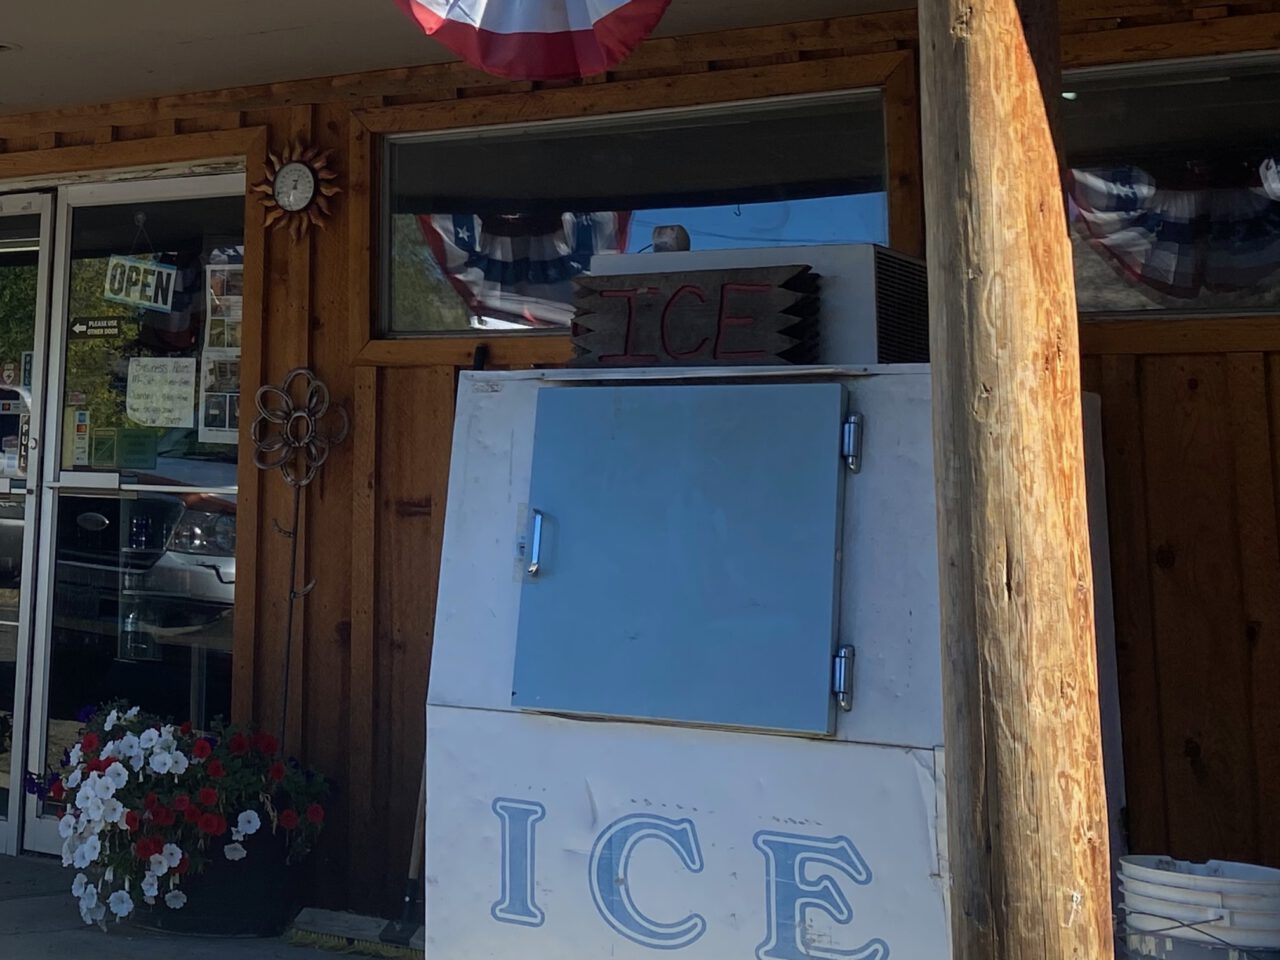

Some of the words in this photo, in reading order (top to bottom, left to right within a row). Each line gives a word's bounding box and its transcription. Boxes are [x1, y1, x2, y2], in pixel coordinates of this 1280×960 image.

[111, 262, 172, 306] OPEN
[598, 282, 774, 364] ICE
[20, 424, 29, 467] PULL
[491, 796, 889, 960] ICE
